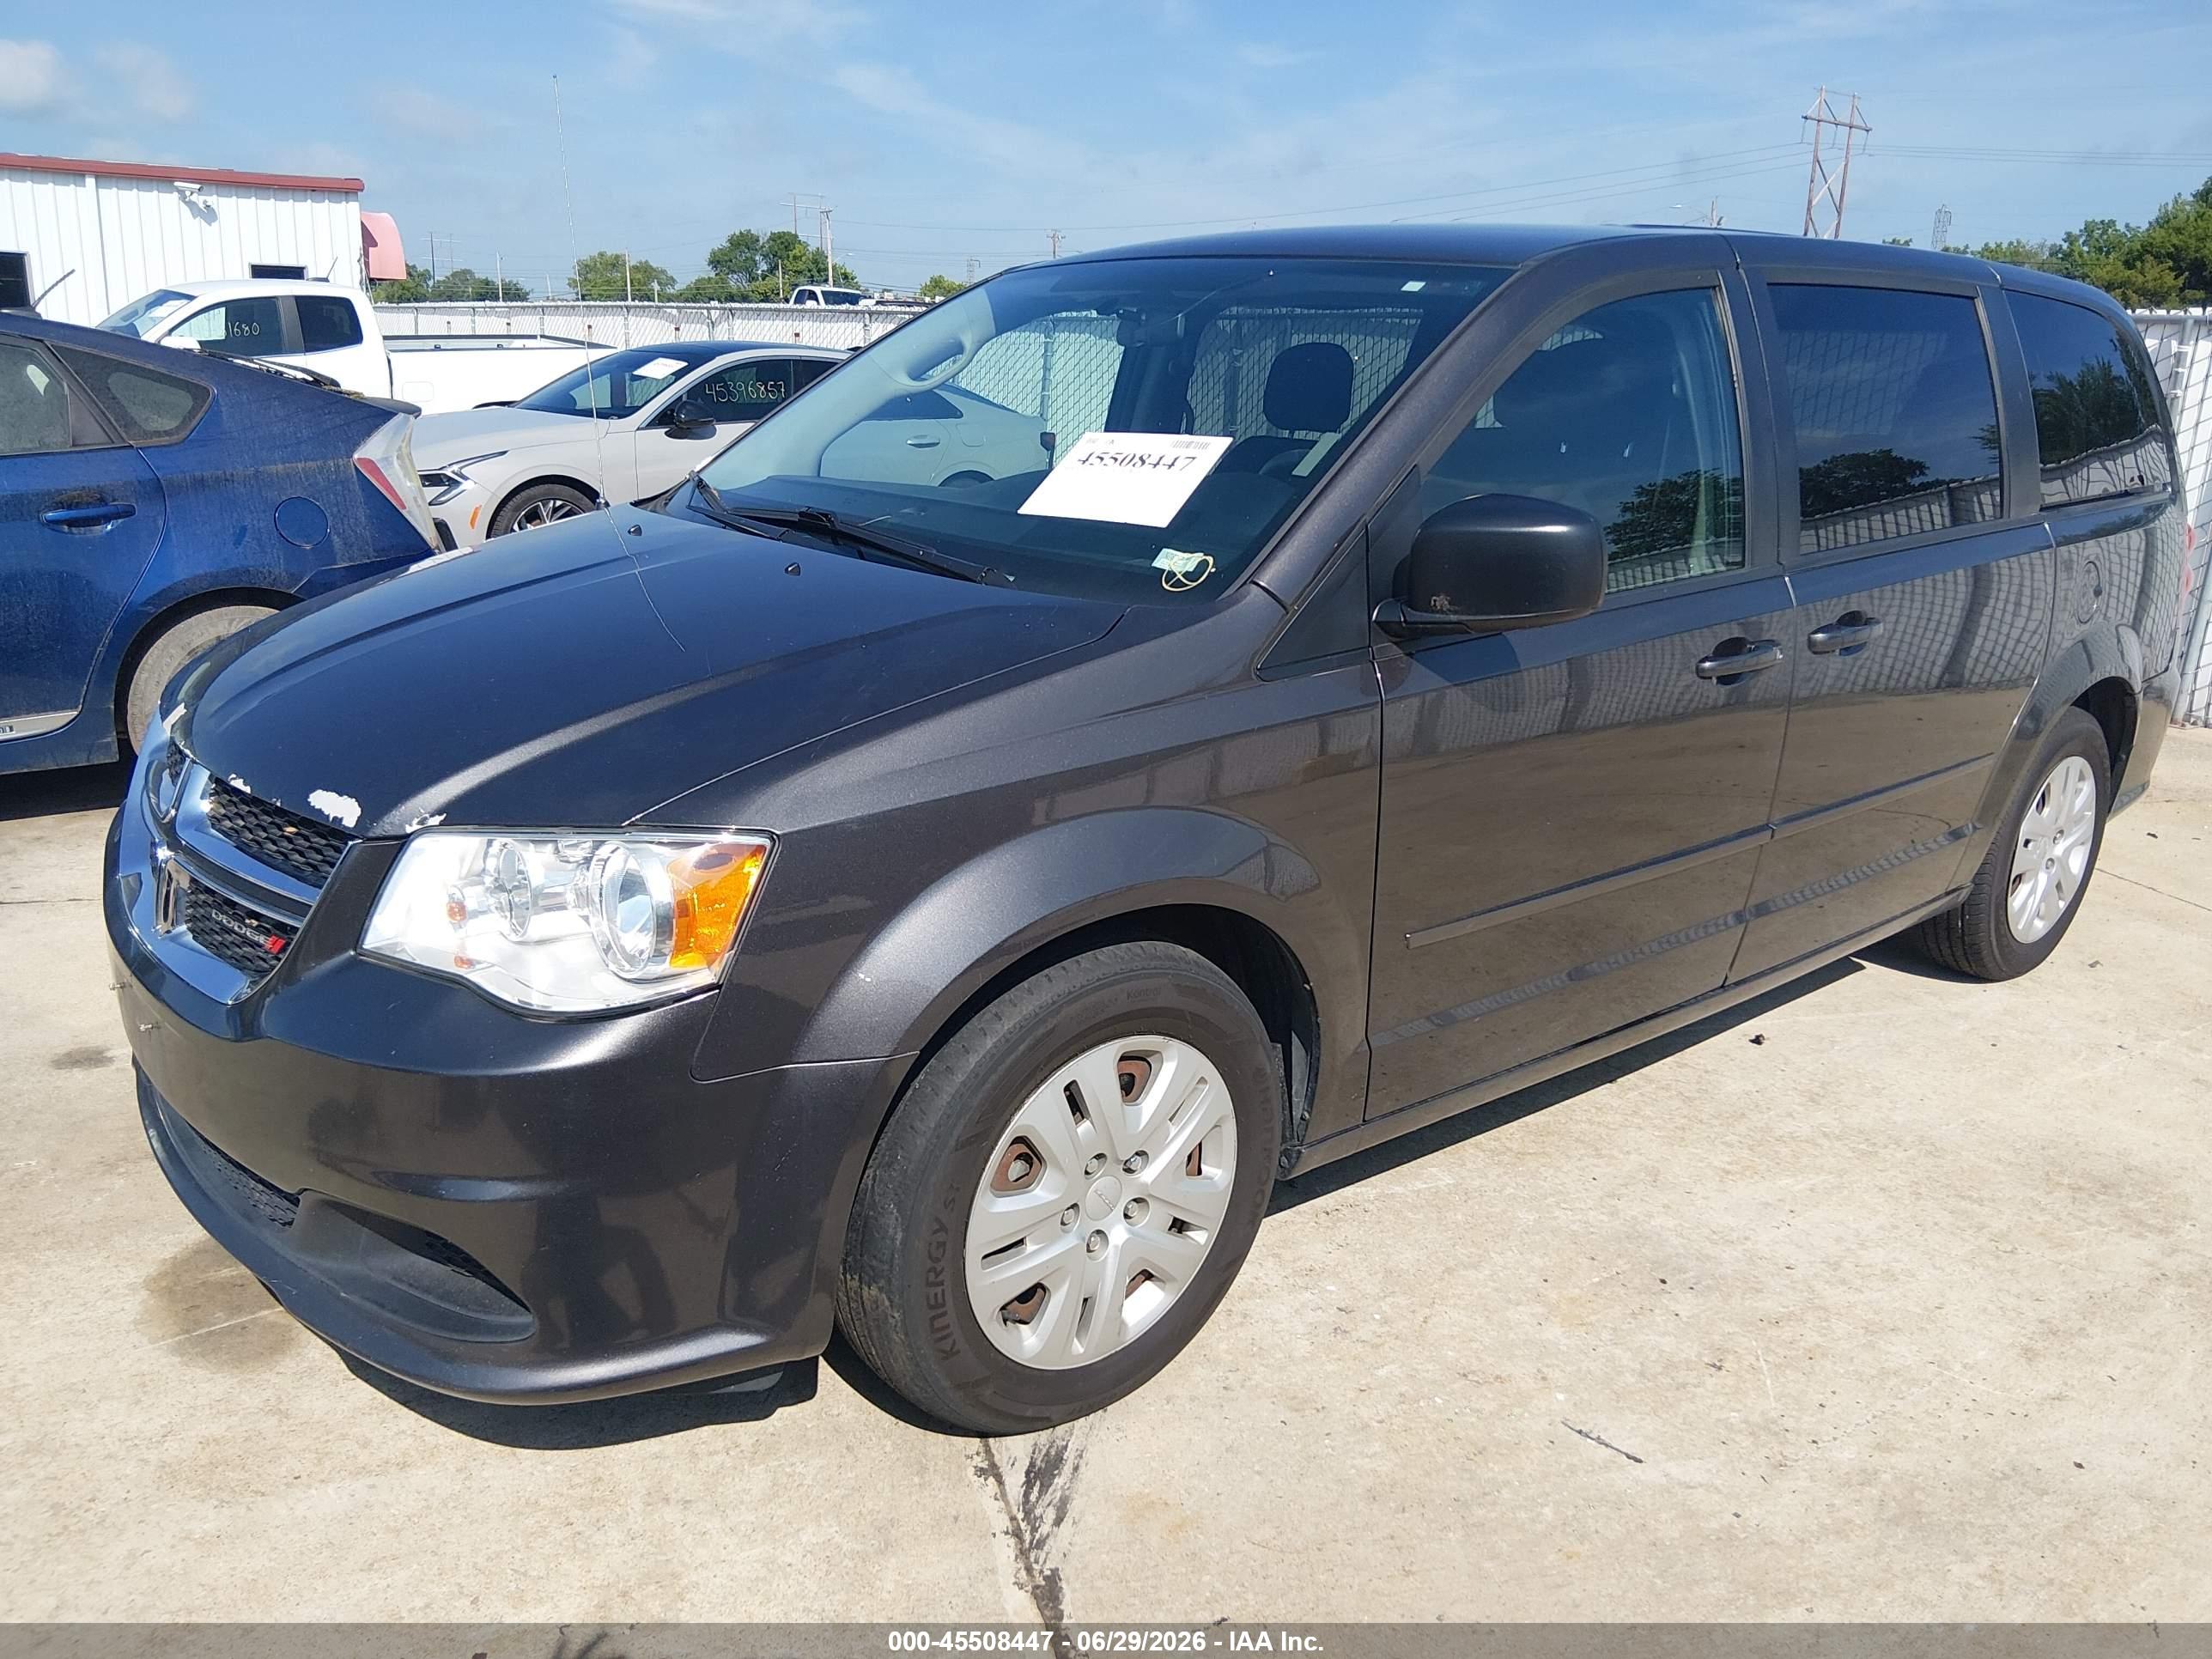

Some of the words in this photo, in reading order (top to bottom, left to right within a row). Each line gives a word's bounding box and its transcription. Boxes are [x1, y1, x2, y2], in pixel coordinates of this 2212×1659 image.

[705, 380, 786, 403] 45396857
[1078, 452, 1198, 471] 45508447
[212, 909, 272, 949] DODGE
